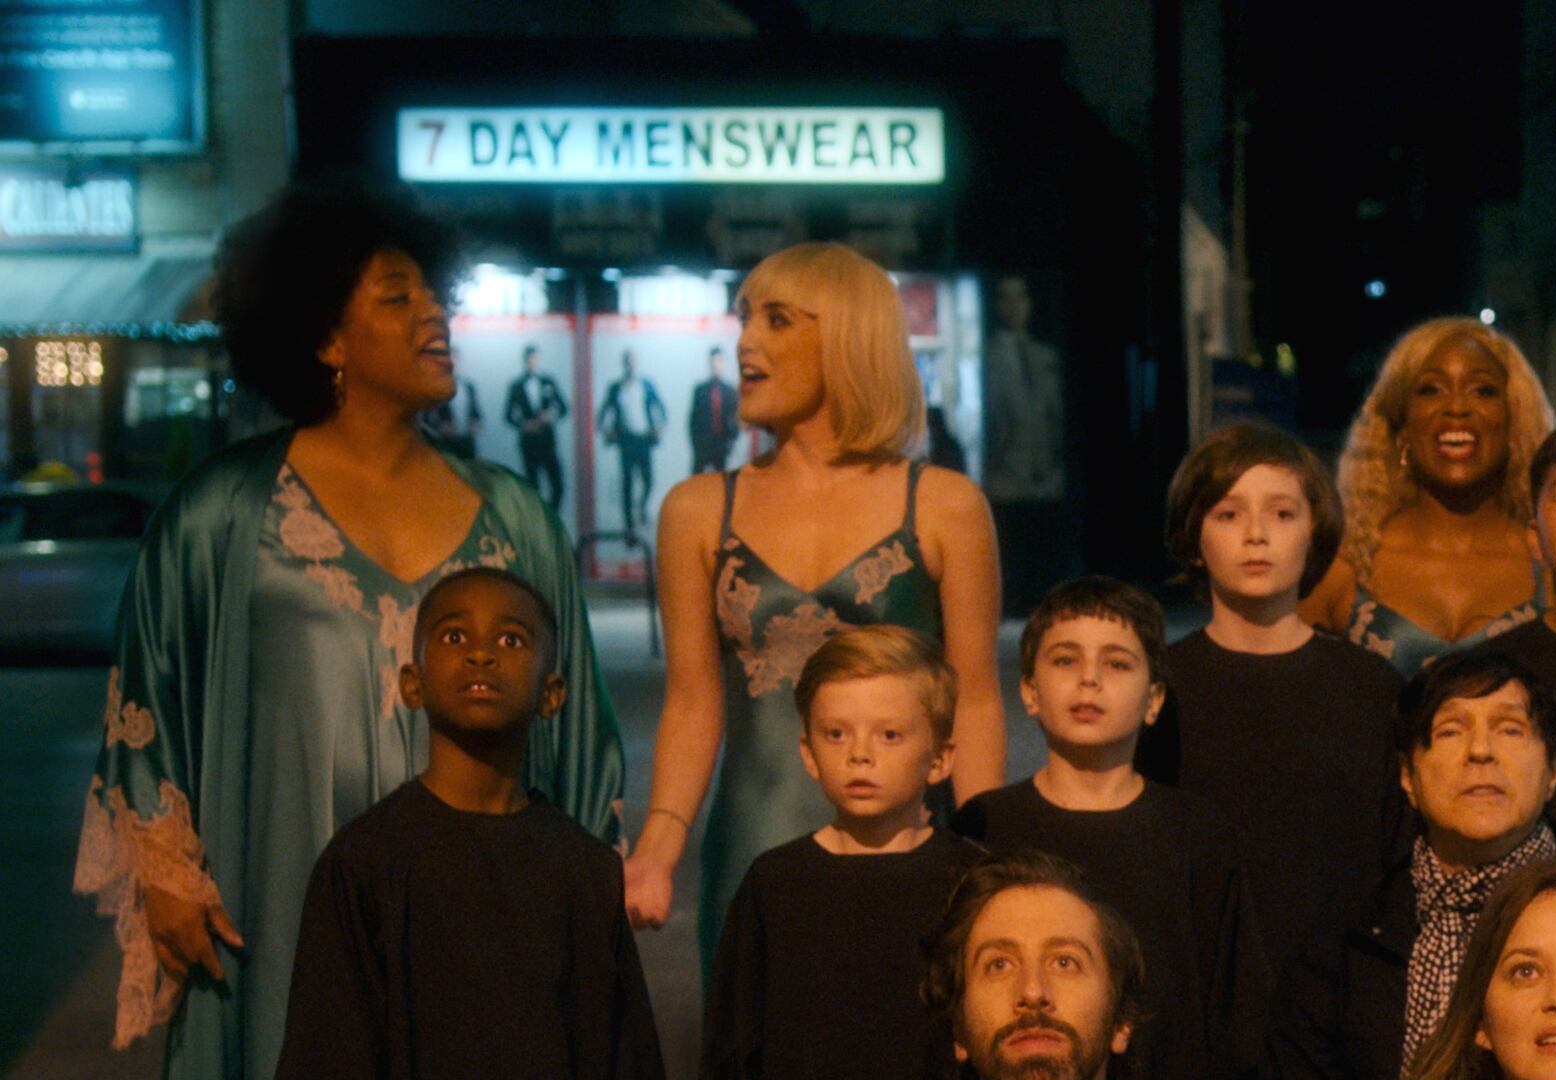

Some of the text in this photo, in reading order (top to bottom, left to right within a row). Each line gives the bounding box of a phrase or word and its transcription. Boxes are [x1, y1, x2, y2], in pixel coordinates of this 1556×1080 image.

[418, 119, 919, 168] 7 DAY MENSWEAR
